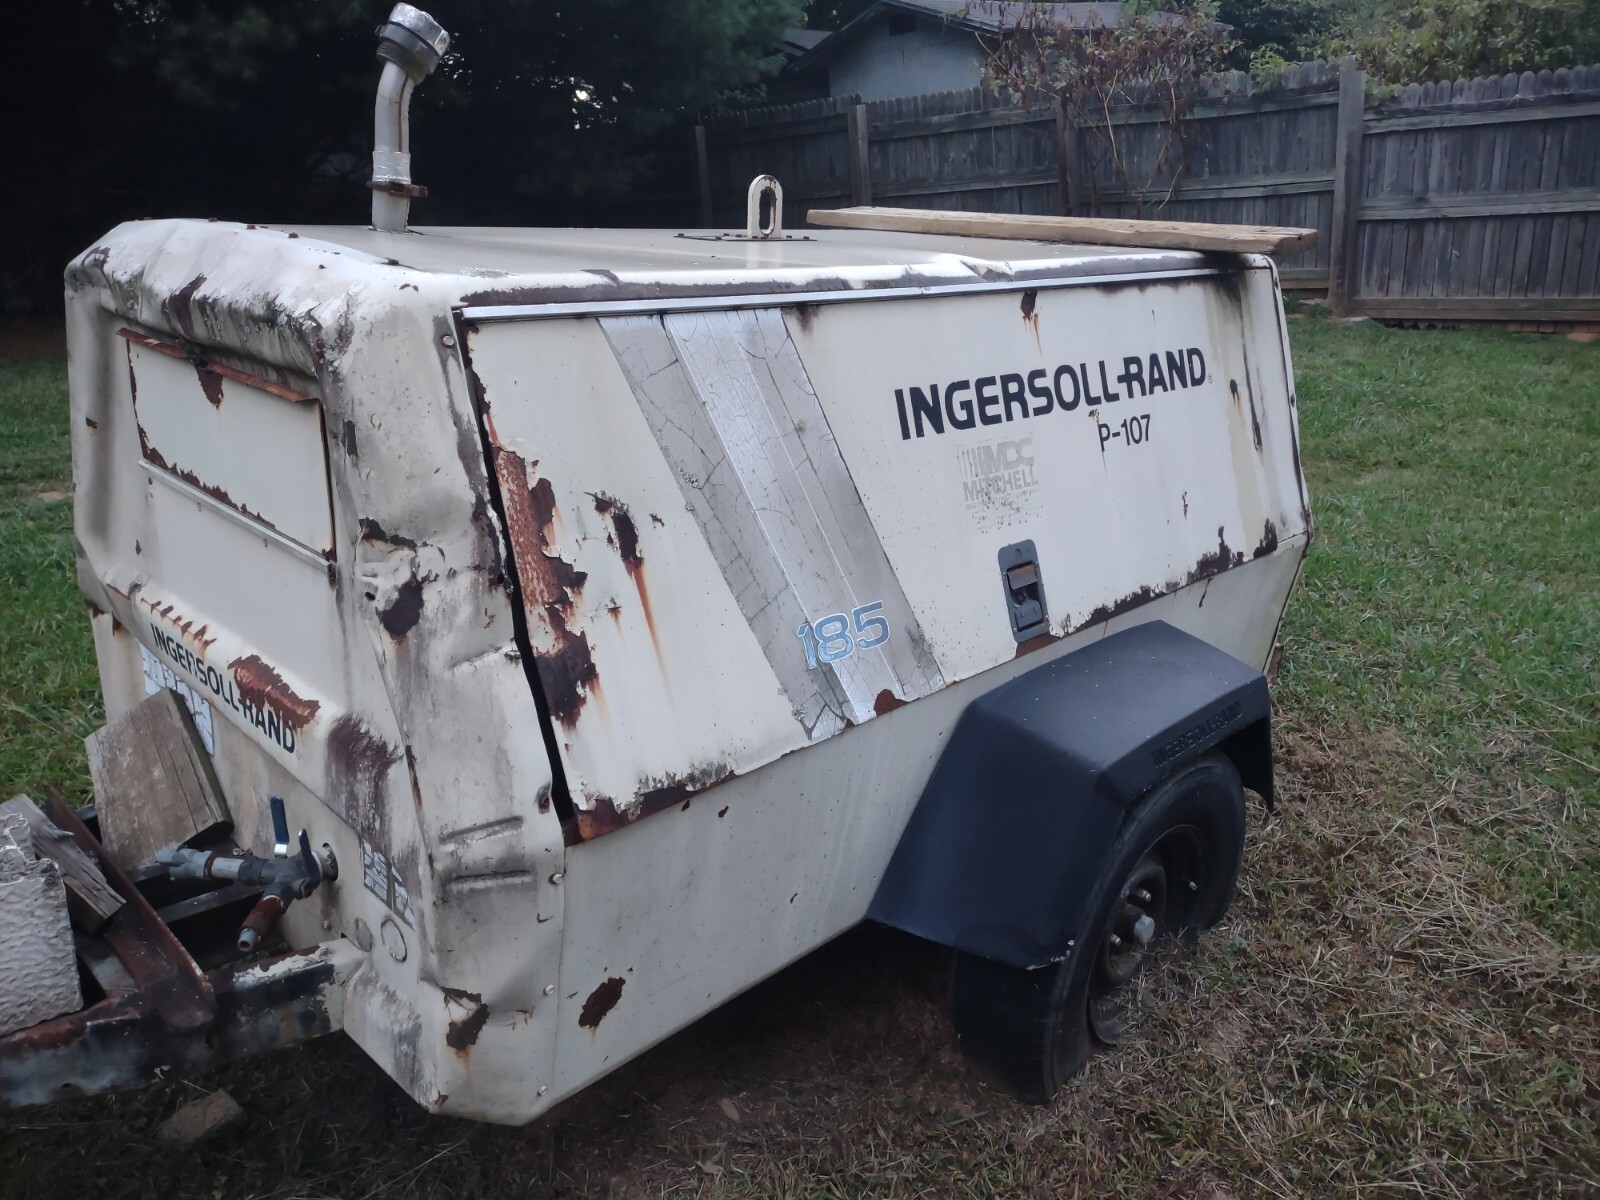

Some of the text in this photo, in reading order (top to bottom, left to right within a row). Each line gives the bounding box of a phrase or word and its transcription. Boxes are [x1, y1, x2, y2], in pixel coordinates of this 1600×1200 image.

[894, 347, 1206, 440] INGERSOLL-RAND
[1098, 414, 1151, 452] P-107
[797, 600, 890, 670] 185
